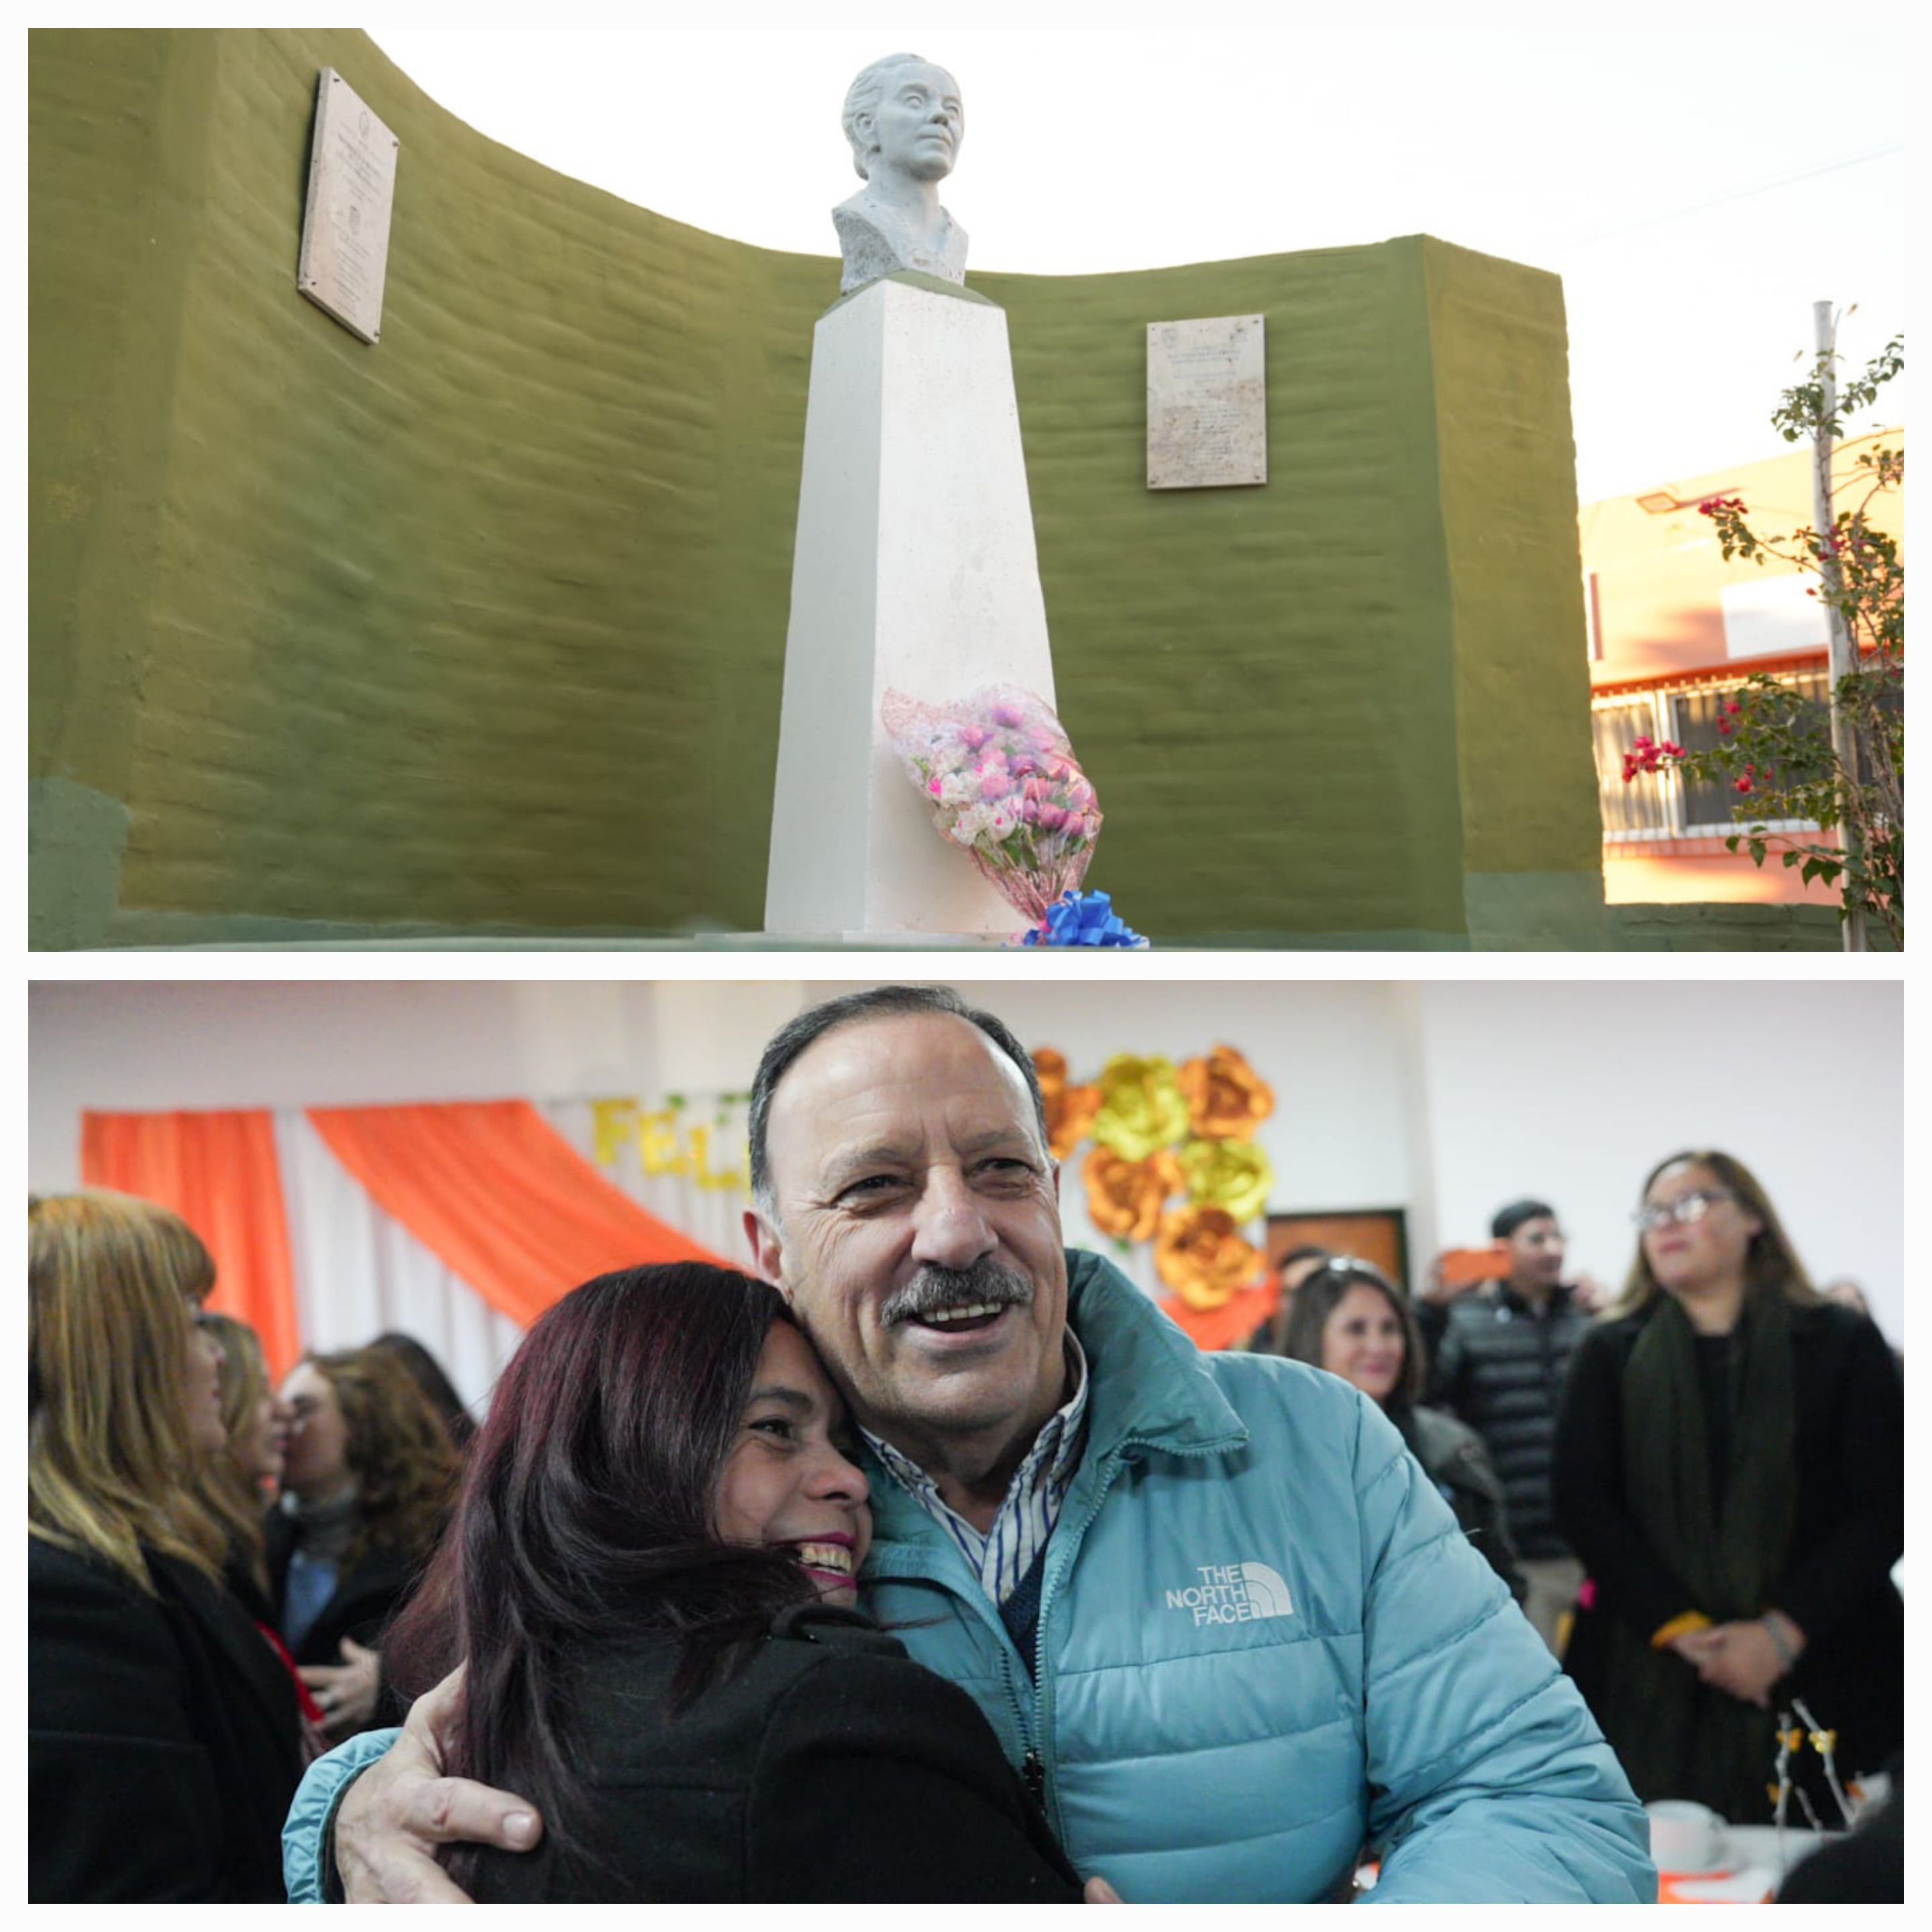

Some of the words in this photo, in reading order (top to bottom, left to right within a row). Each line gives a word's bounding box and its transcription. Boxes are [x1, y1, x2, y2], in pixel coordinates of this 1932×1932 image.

[592, 1099, 753, 1203] FEL
[1197, 1566, 1242, 1584] THE
[1166, 1585, 1248, 1609] NORTH
[1193, 1603, 1252, 1627] FACE
